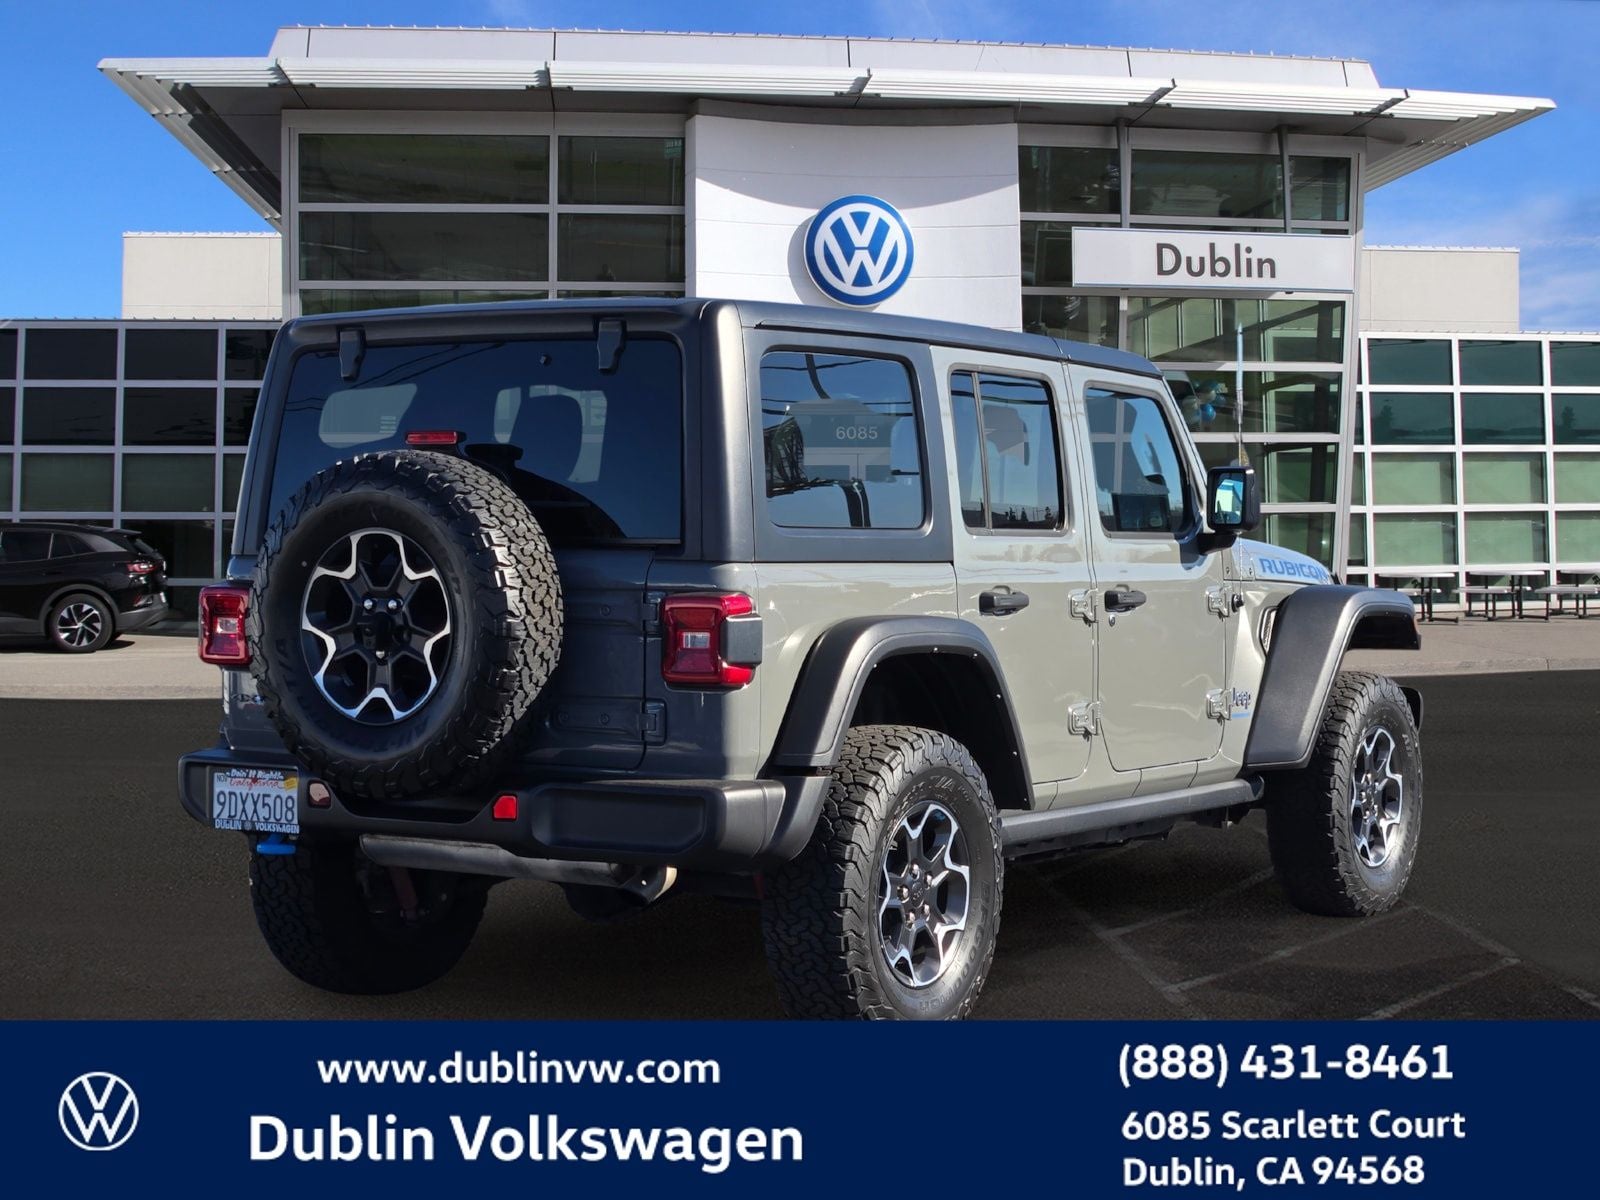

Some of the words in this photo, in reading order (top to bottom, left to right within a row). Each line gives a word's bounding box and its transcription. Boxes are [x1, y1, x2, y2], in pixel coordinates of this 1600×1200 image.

[812, 202, 907, 296] VW
[1156, 242, 1277, 279] Dublin
[835, 426, 878, 440] 6085
[1259, 558, 1329, 580] RUBICON
[216, 791, 295, 822] 9DXX508
[215, 820, 241, 830] DUBLIN
[255, 822, 299, 834] VOLKSWAGEN
